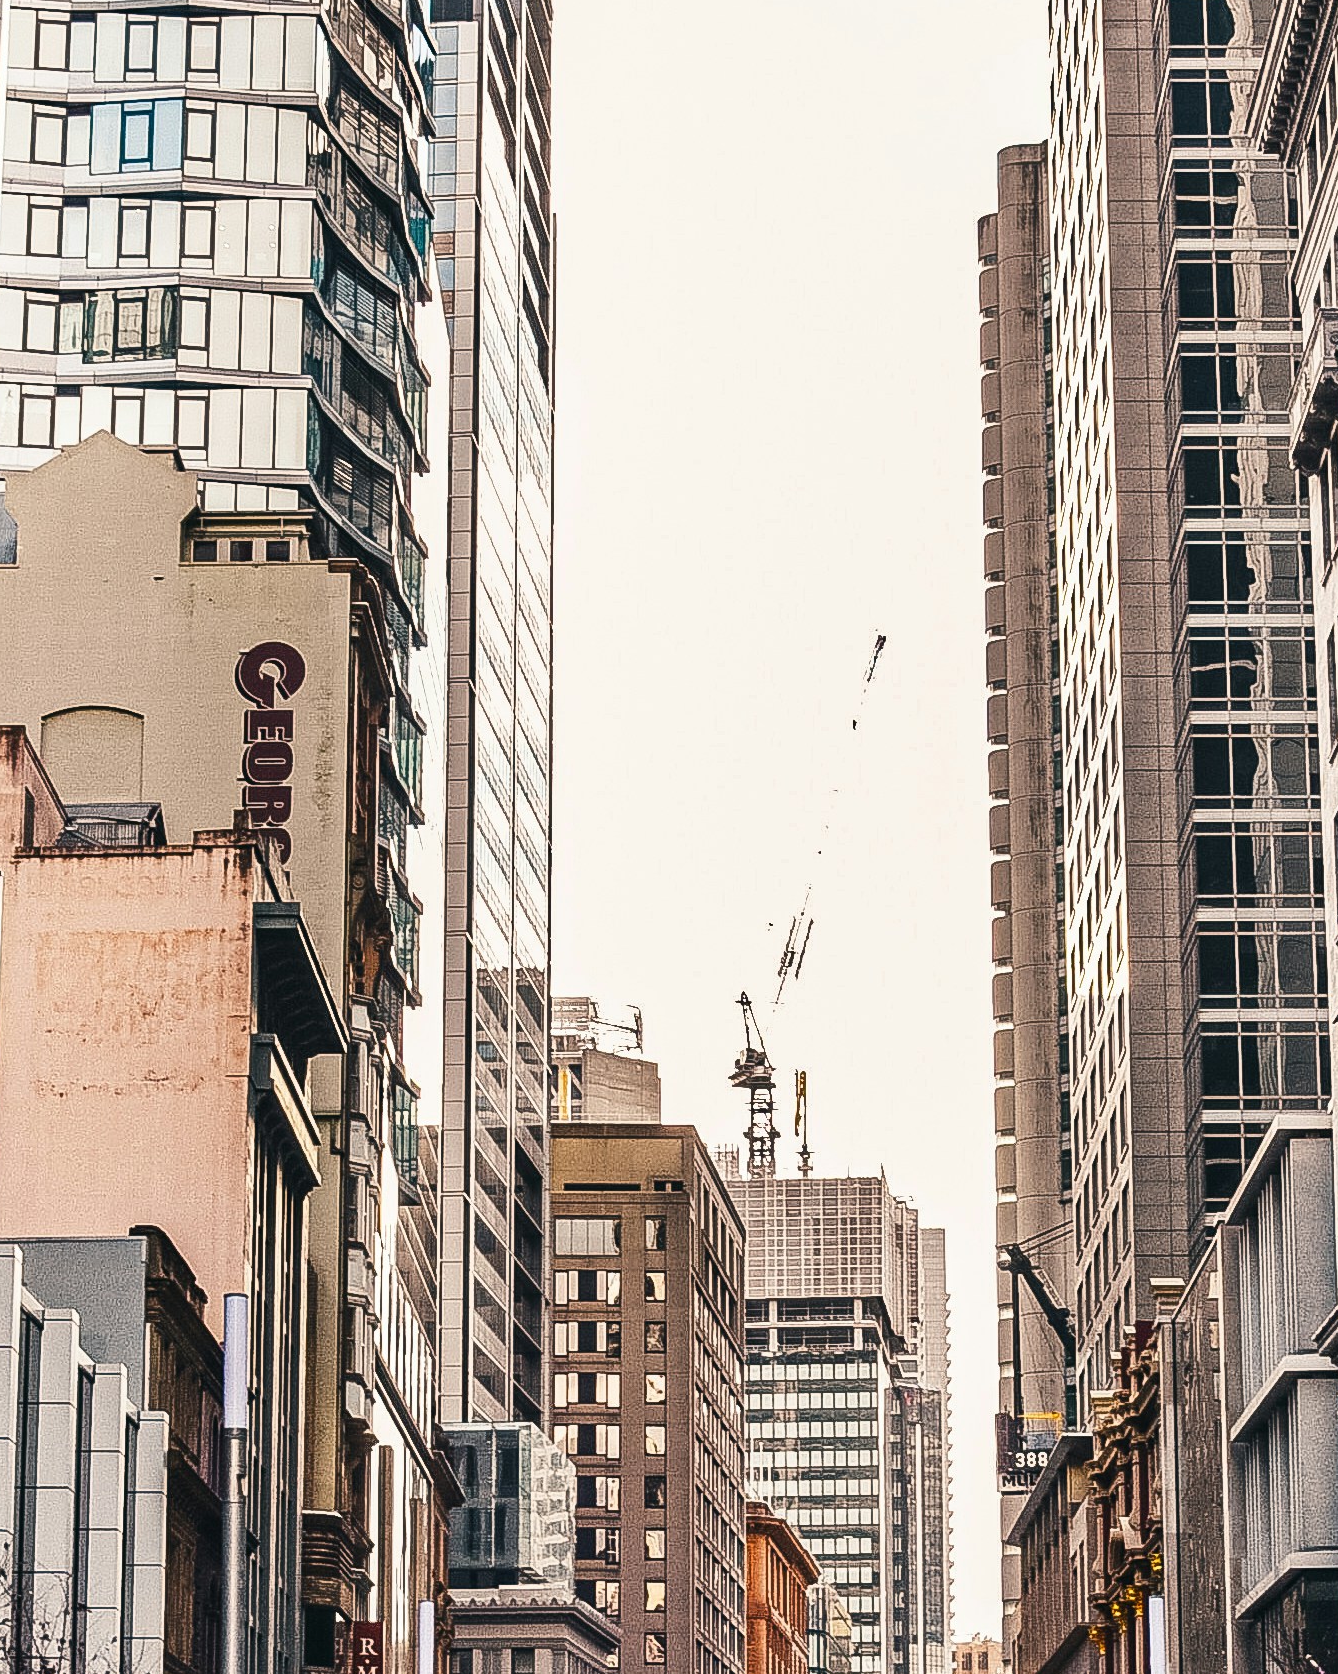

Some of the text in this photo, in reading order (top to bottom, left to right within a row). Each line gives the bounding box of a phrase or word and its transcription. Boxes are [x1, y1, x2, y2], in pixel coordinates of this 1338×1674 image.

[234, 641, 306, 879] GEORG
[1015, 1452, 1048, 1468] 388
[1002, 1474, 1037, 1487] MUL
